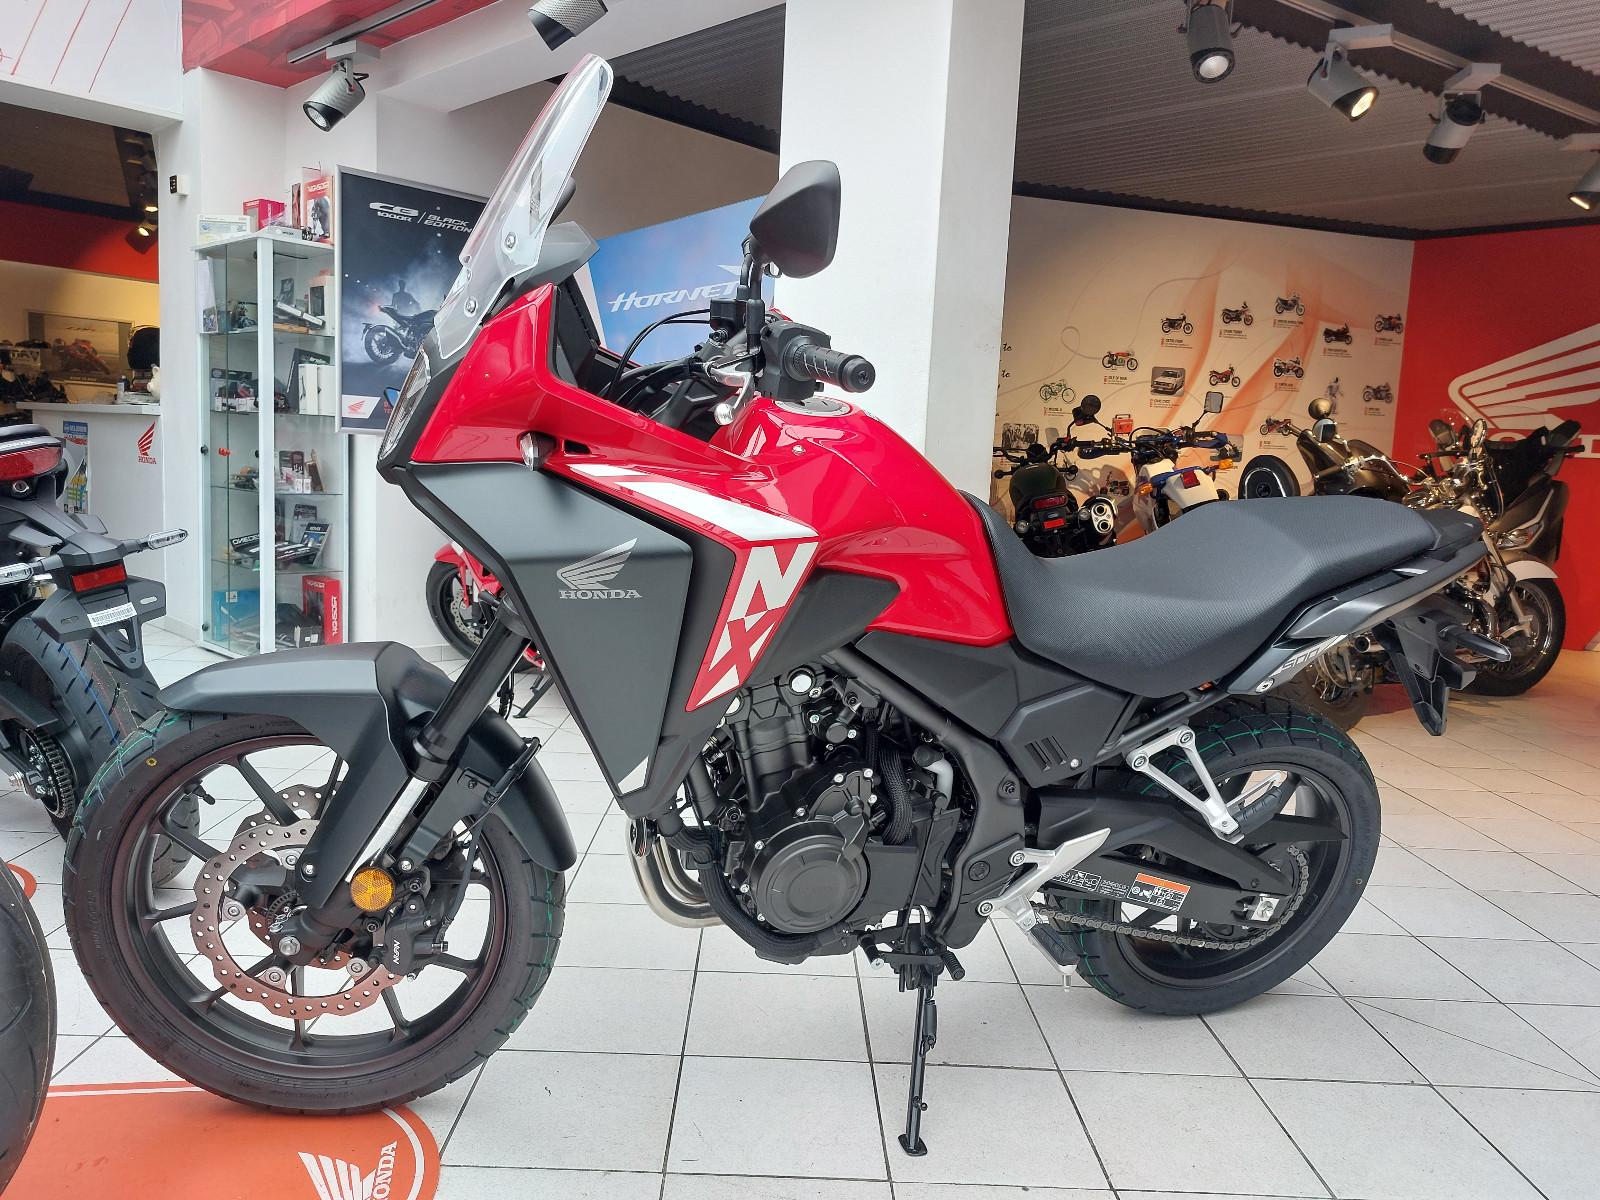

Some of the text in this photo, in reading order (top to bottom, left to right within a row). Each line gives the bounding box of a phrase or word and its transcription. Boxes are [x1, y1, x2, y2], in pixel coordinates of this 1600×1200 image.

[369, 202, 419, 217] CB
[377, 211, 412, 222] 1000R
[427, 214, 470, 227] BLACK
[423, 219, 473, 233] EDITION
[608, 280, 740, 313] HORNET
[137, 455, 157, 465] HONDA
[559, 589, 642, 600] HONDA
[371, 1140, 398, 1200] ONDA
